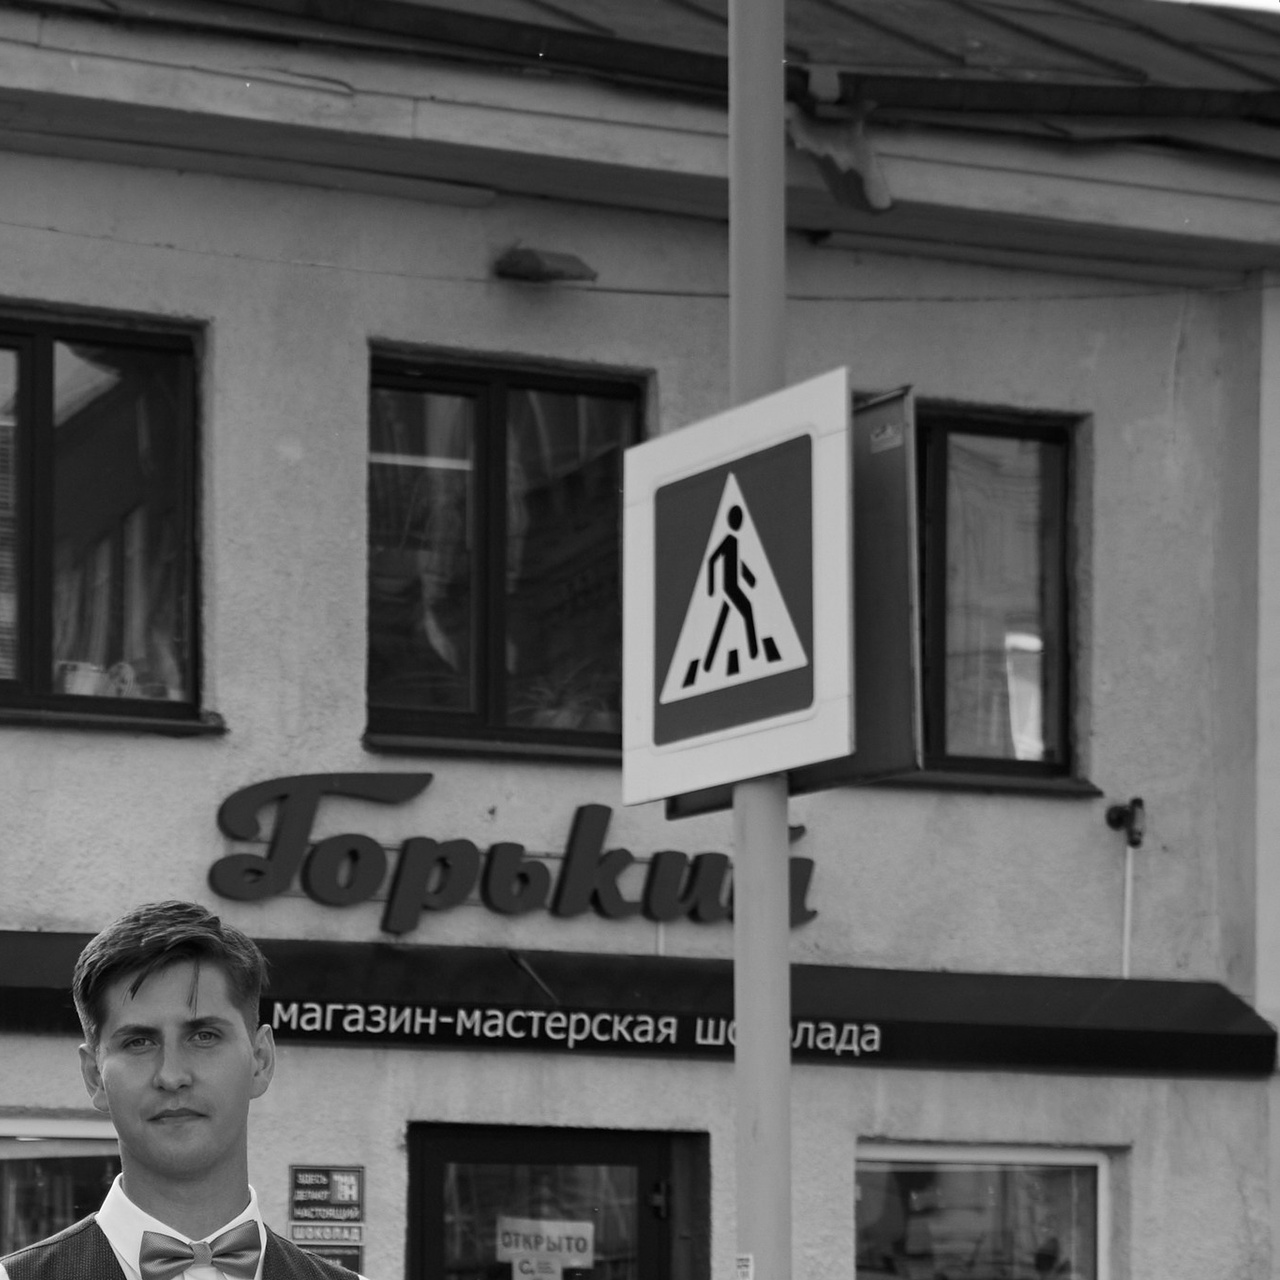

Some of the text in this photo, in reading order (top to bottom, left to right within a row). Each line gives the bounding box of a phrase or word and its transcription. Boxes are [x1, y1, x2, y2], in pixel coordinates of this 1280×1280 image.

[272, 1001, 882, 1057] магазин-мастерская шлада
[293, 1226, 360, 1240] ШОКОЛАД
[501, 1231, 588, 1254] ОТКРЫТО
